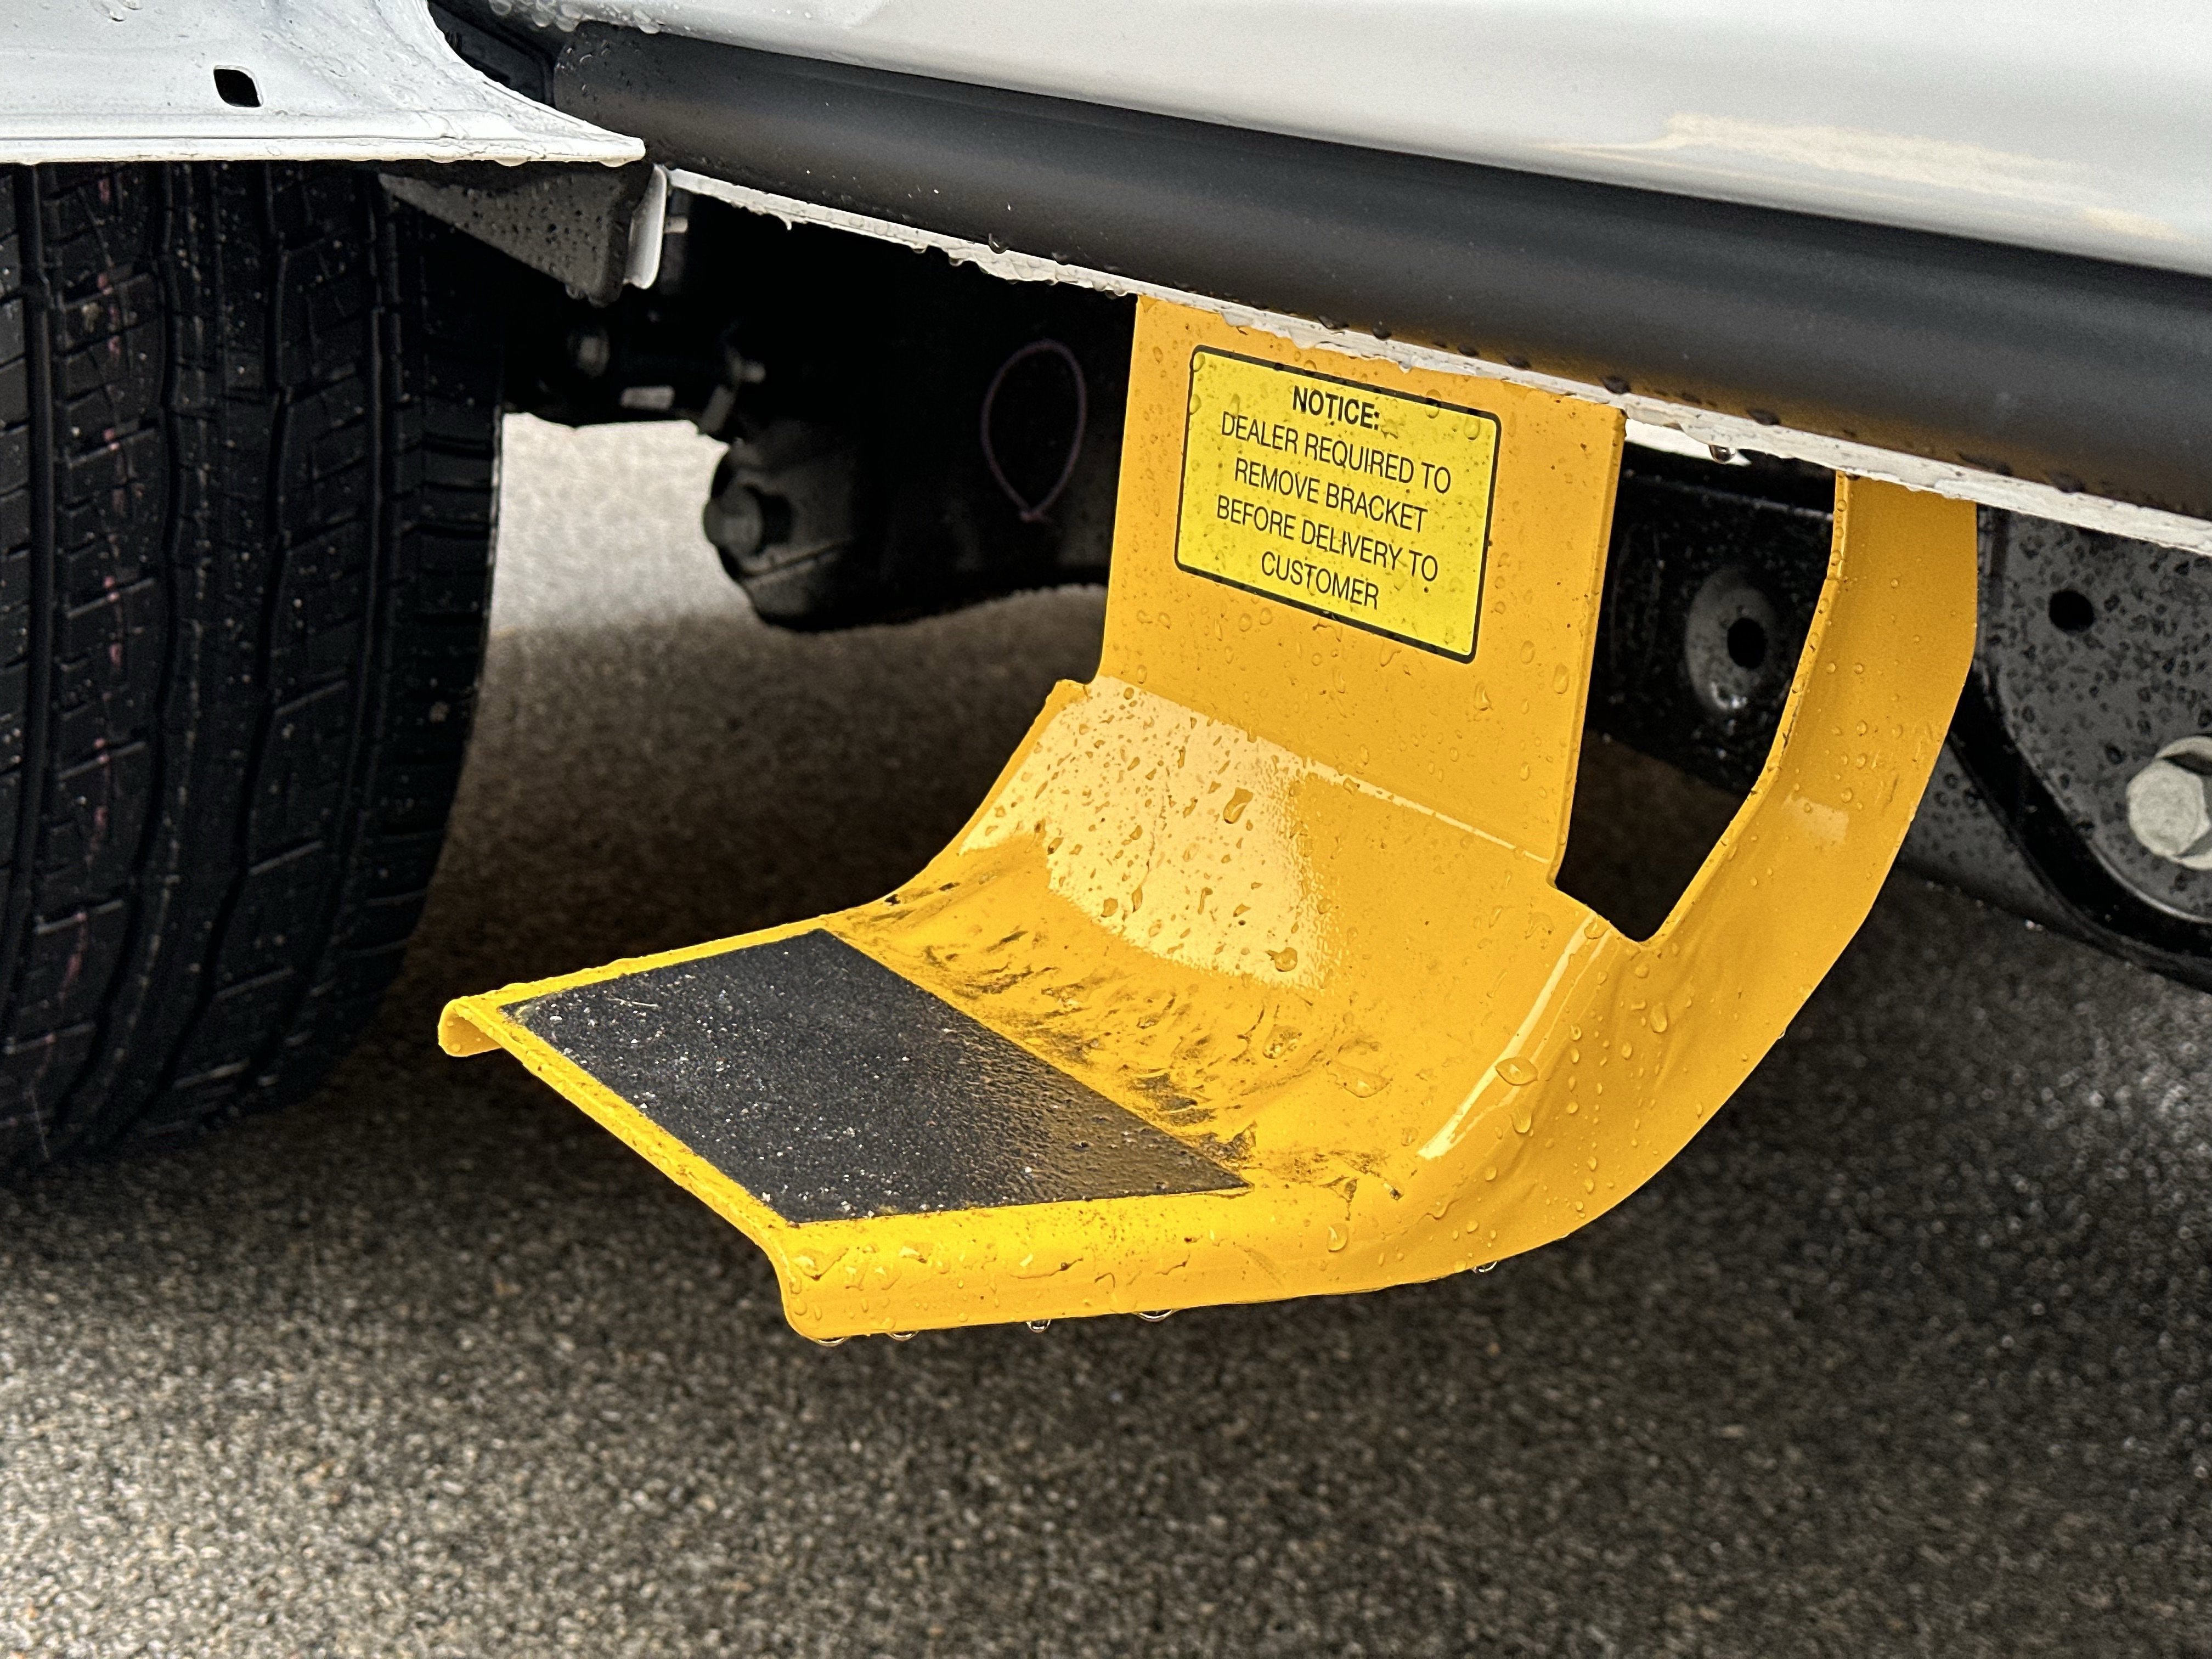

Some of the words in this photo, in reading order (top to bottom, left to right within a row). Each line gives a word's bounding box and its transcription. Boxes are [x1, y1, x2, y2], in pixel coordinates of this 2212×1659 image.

[1293, 385, 1380, 430] NOTICE:
[1222, 411, 1298, 455] DEALER
[1305, 432, 1414, 484] REQUIRED
[1421, 462, 1451, 494] TO
[1235, 458, 1319, 504] REMOVE
[1326, 483, 1427, 533] BRACKET
[1217, 495, 1296, 540] BEFORE
[1301, 520, 1402, 571] DELIVERY
[1408, 550, 1438, 582] TO
[1261, 551, 1379, 610] CUSTOMER
